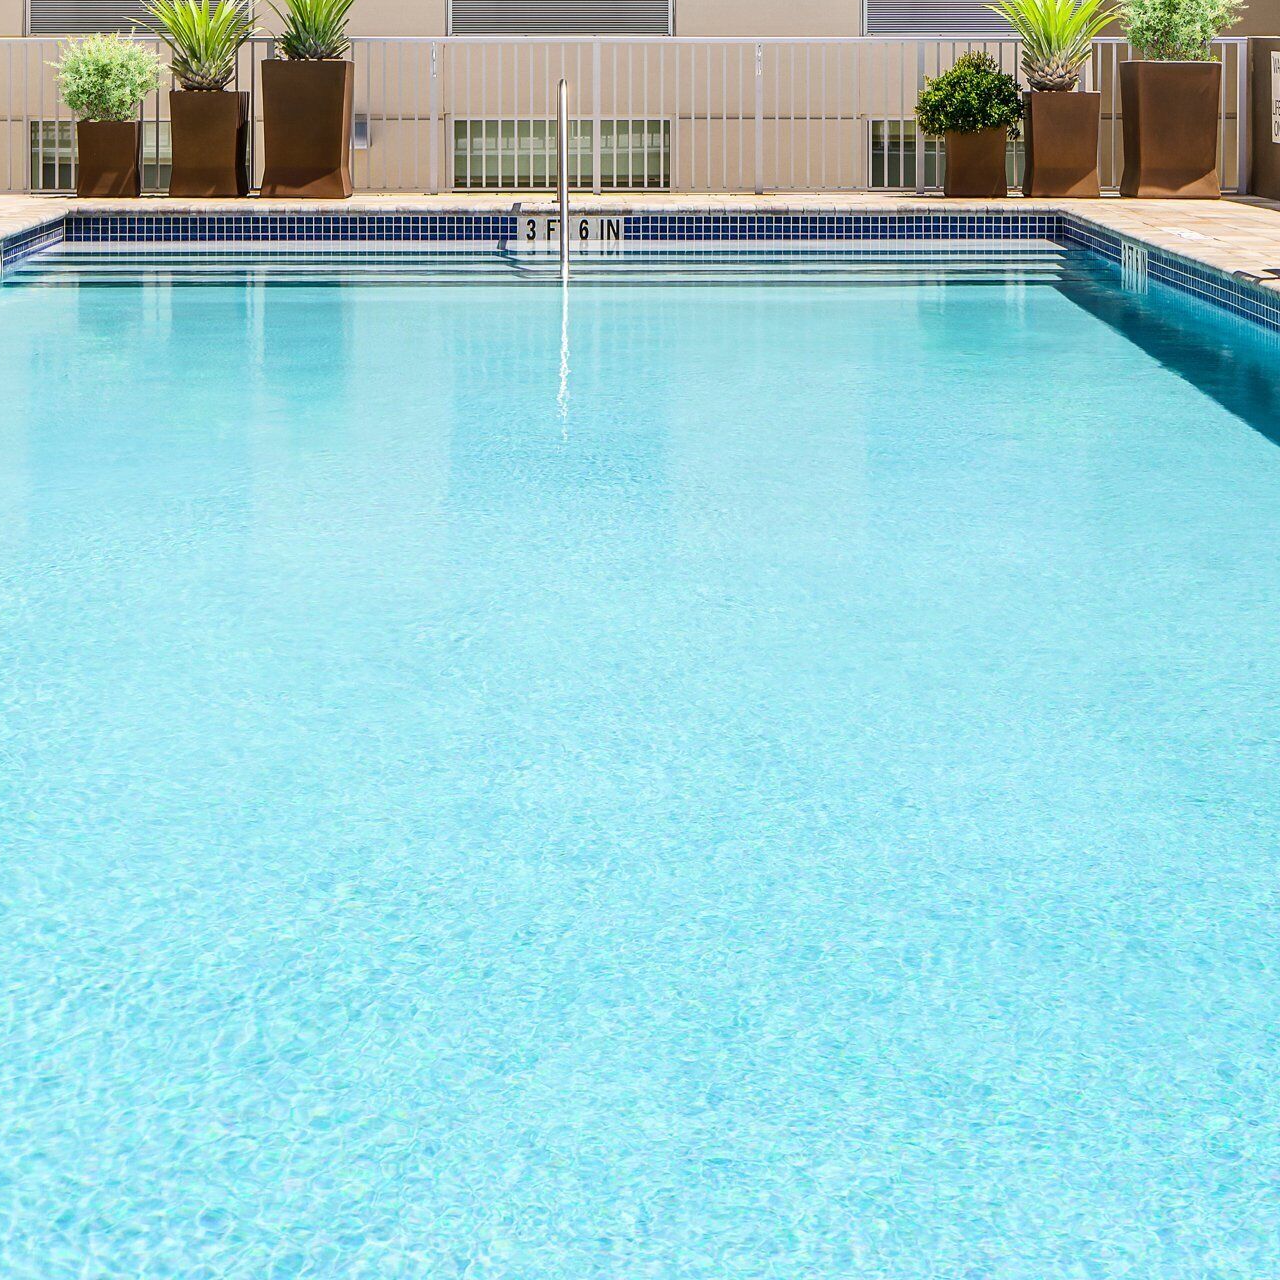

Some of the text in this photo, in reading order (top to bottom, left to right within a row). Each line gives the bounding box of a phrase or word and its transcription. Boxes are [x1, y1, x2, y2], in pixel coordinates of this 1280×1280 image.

[526, 219, 536, 240] 3
[579, 219, 589, 240] 6
[600, 219, 620, 240] IN
